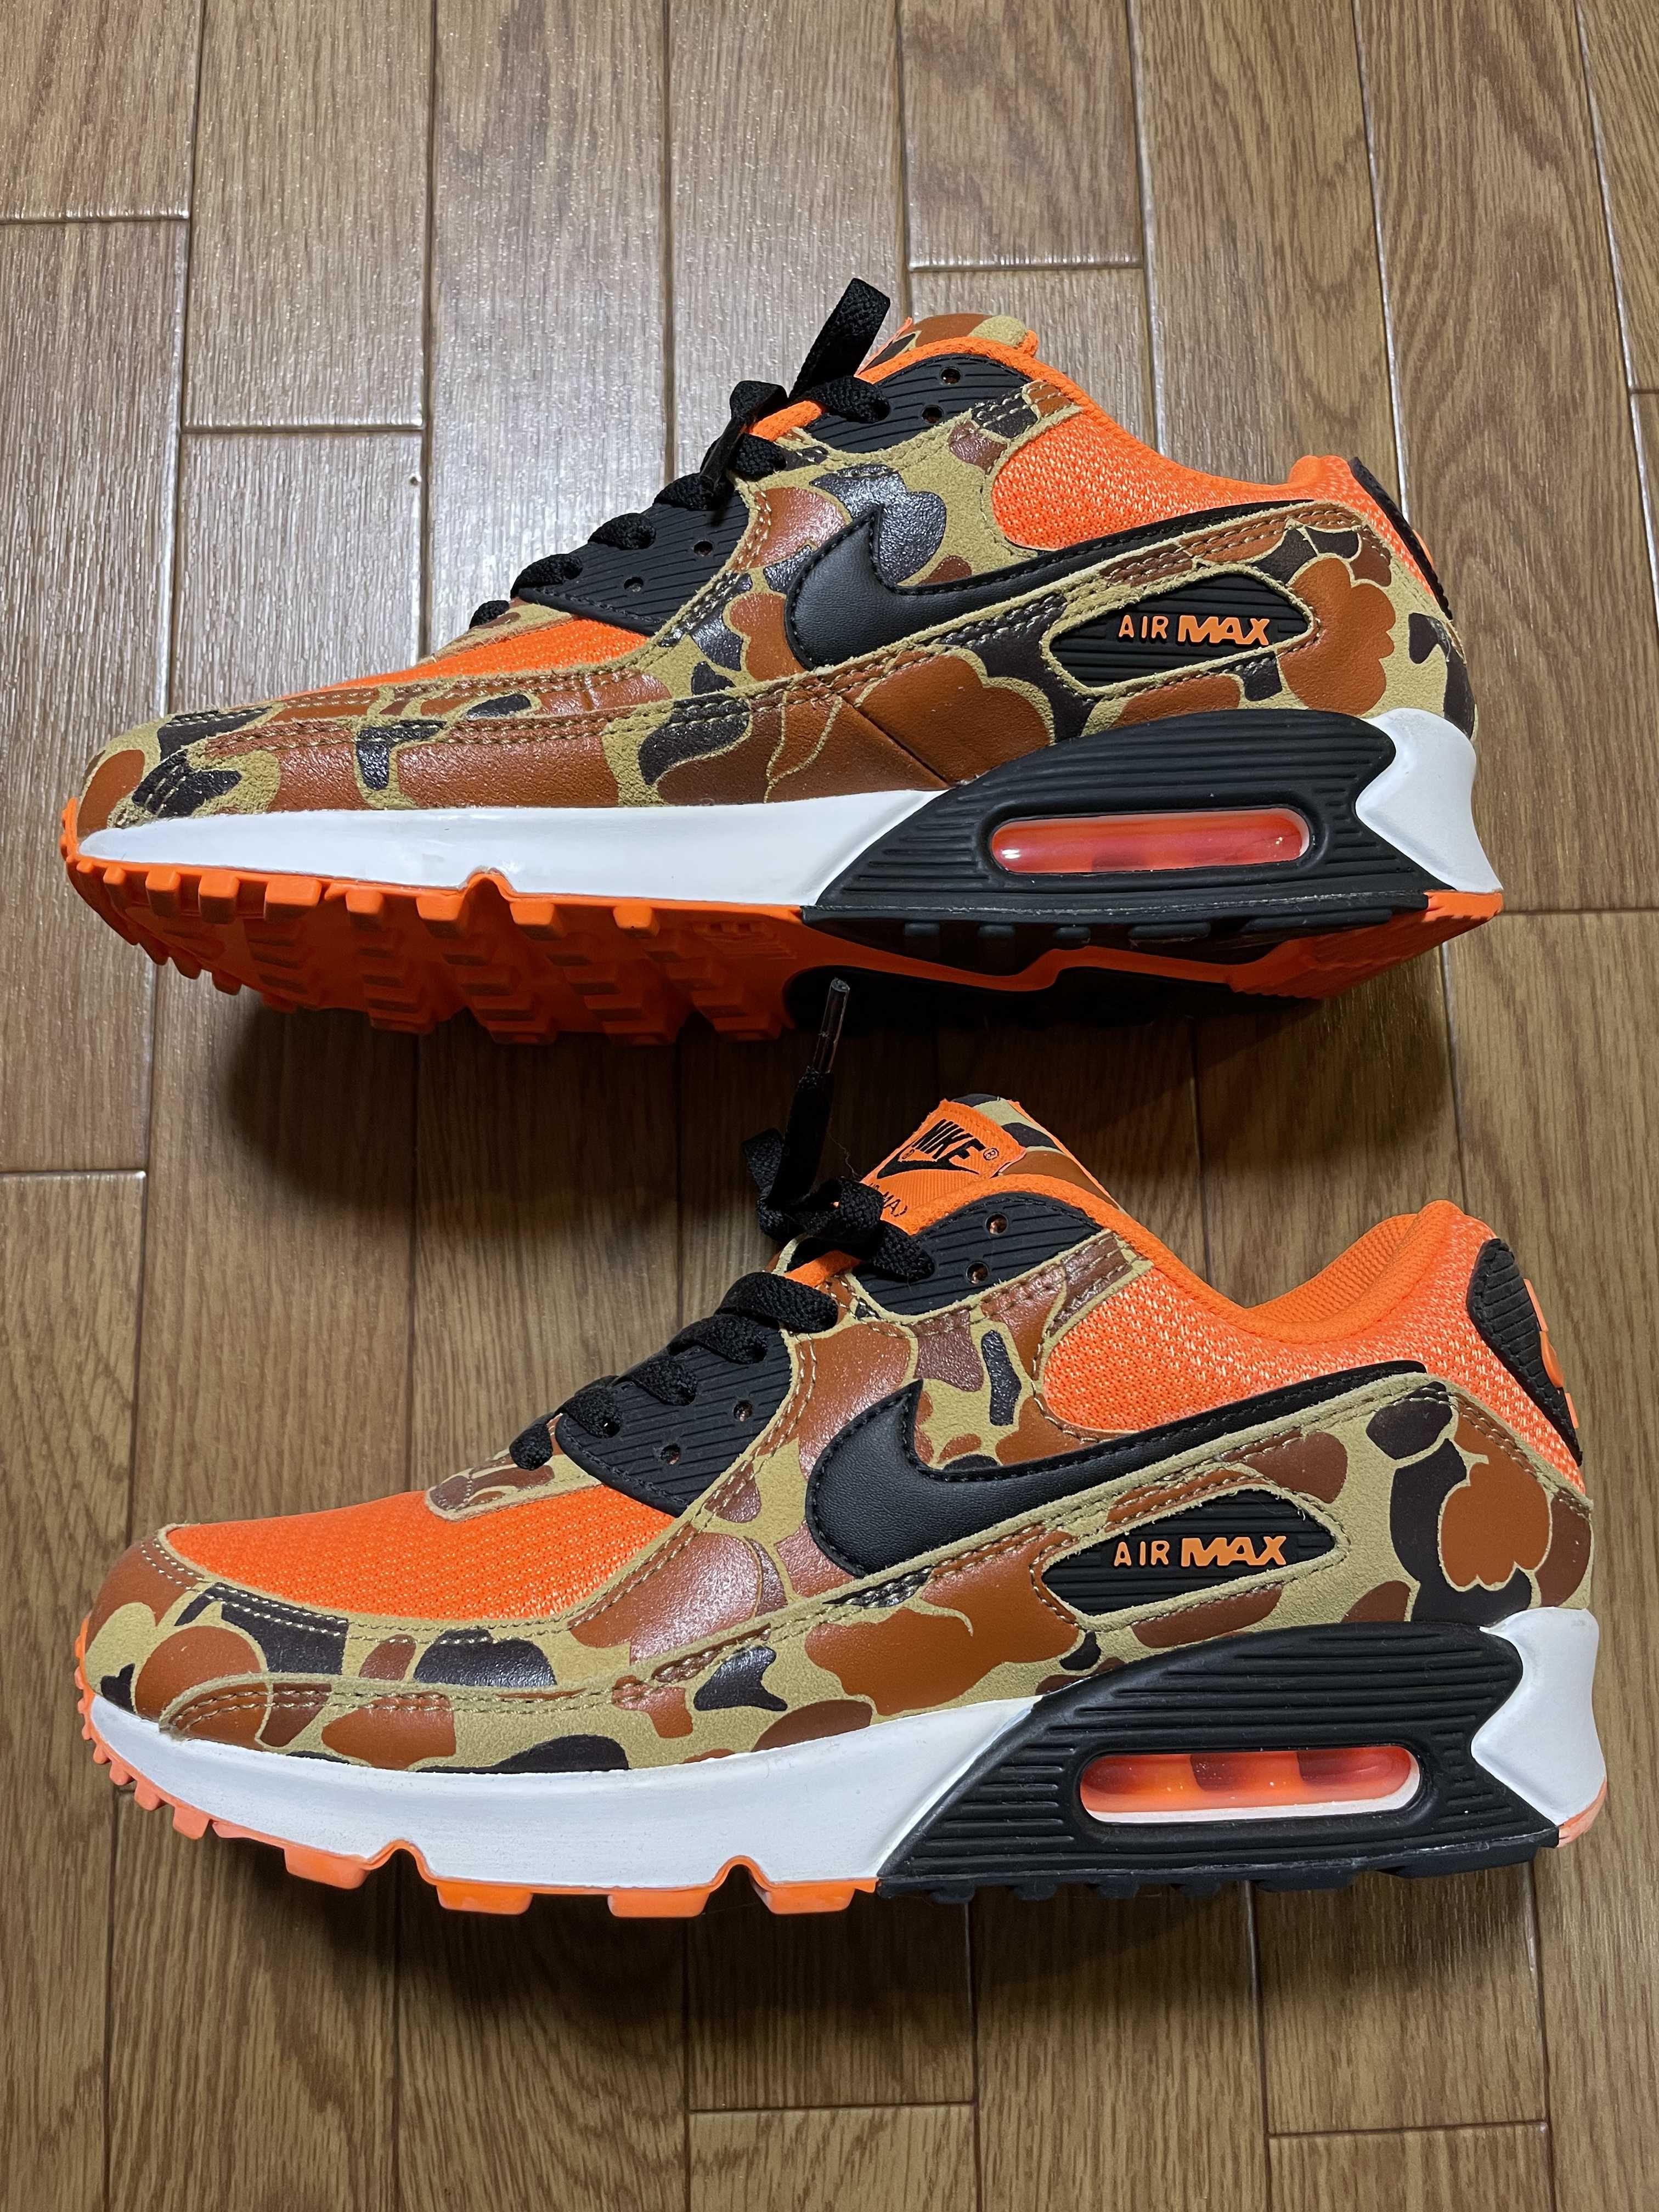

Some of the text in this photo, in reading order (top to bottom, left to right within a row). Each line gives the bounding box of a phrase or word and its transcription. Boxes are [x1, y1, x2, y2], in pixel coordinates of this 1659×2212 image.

[1118, 614, 1271, 646] AIR MAX
[911, 1119, 986, 1164] NIKE
[1113, 1536, 1287, 1567] AIR MAX
